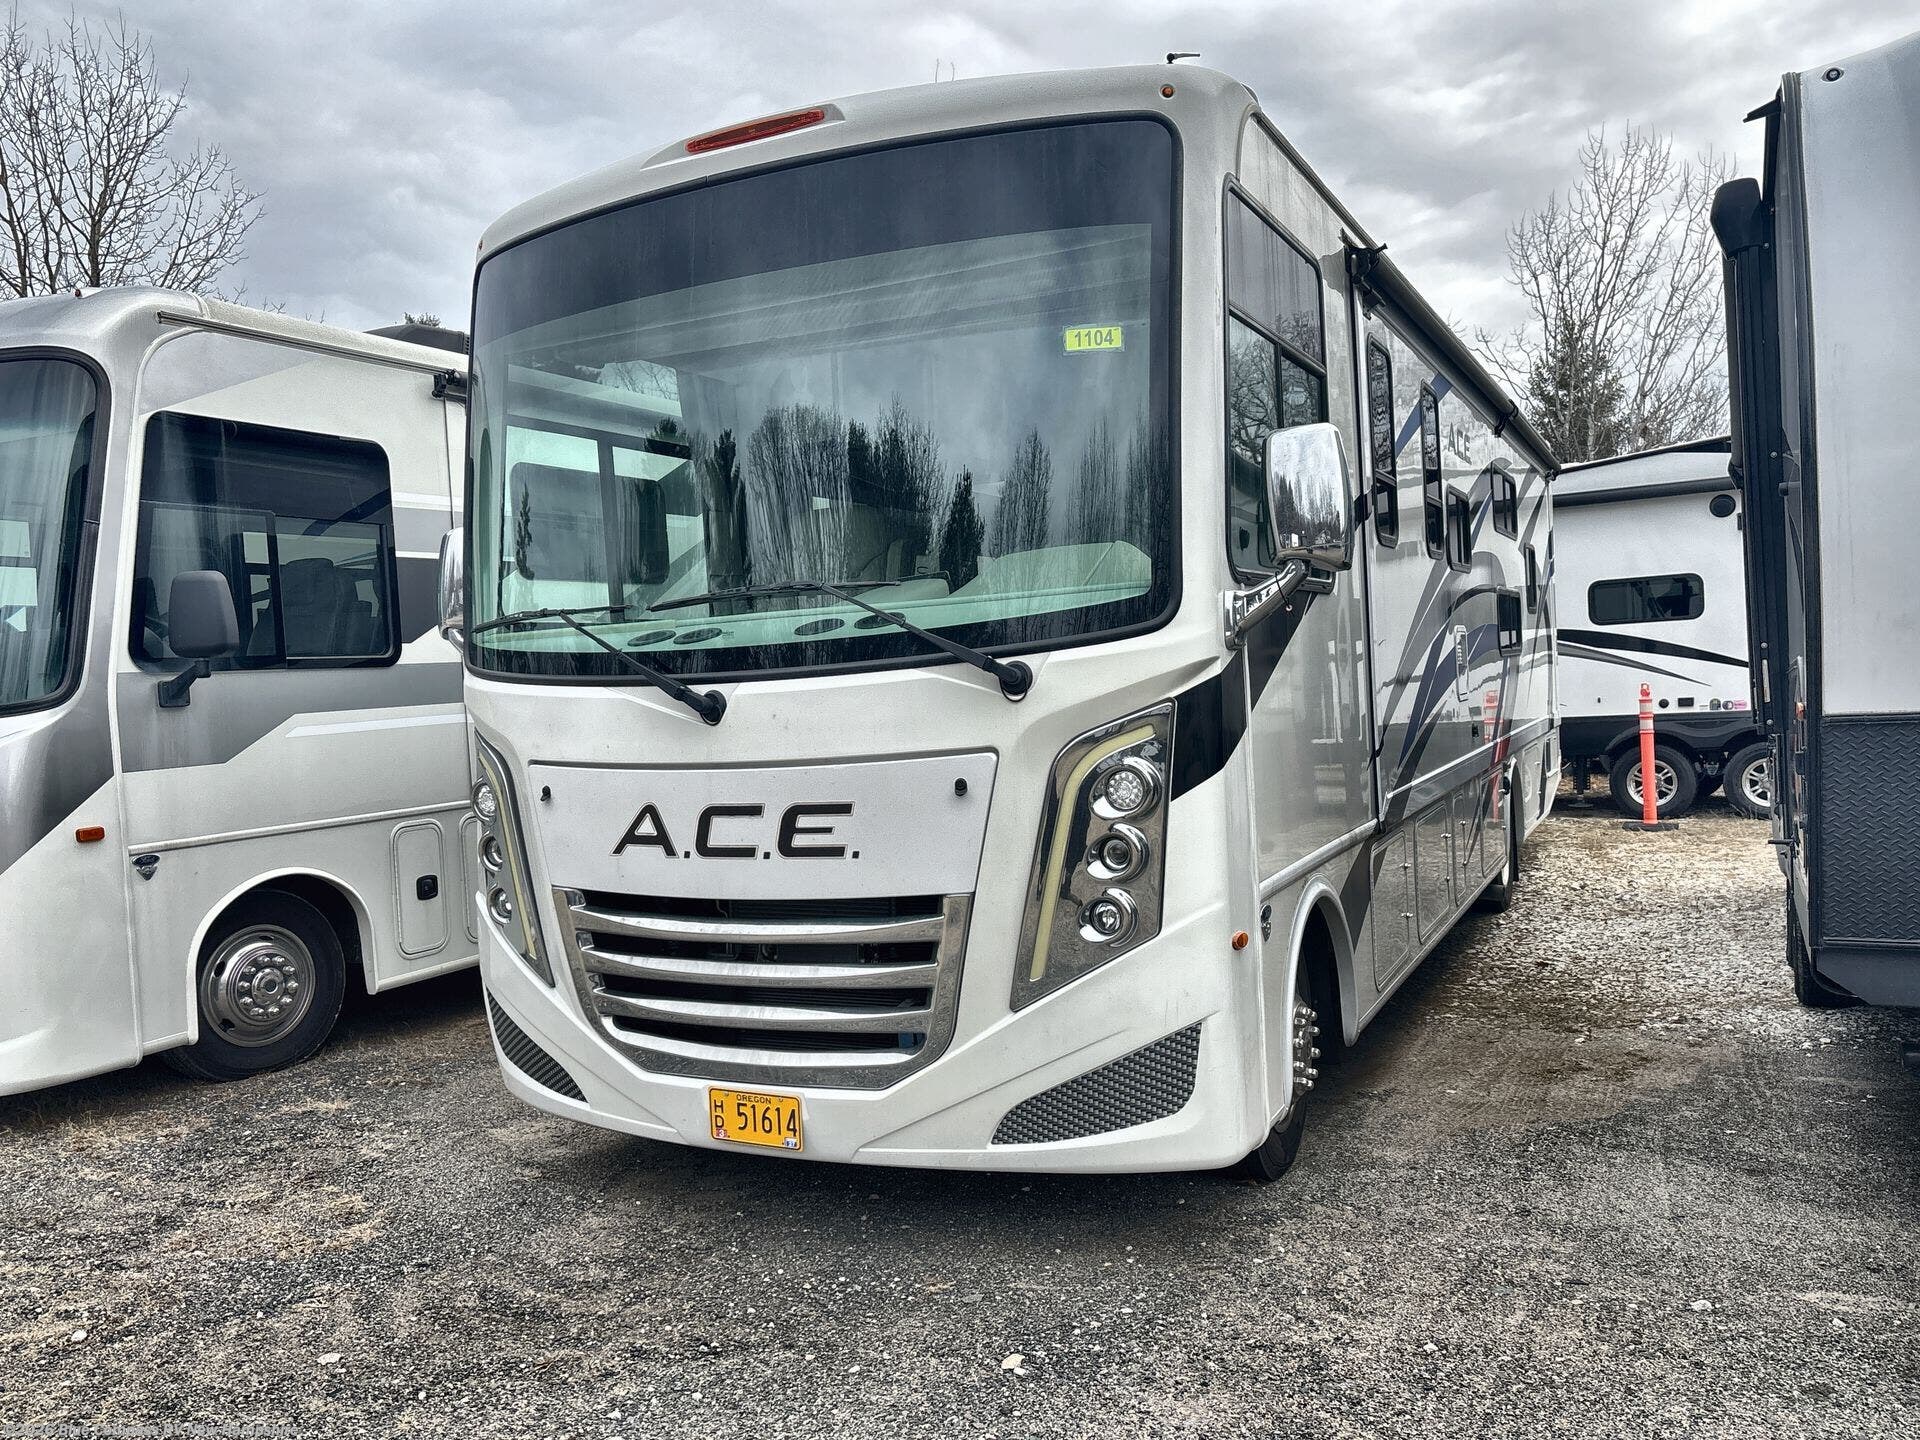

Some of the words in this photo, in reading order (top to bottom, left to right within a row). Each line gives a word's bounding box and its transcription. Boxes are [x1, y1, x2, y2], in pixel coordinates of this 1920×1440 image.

[1074, 329, 1114, 348] 1104
[609, 801, 860, 860] A.C.E.
[736, 1093, 772, 1104] OREGON
[736, 1102, 798, 1137] 51614
